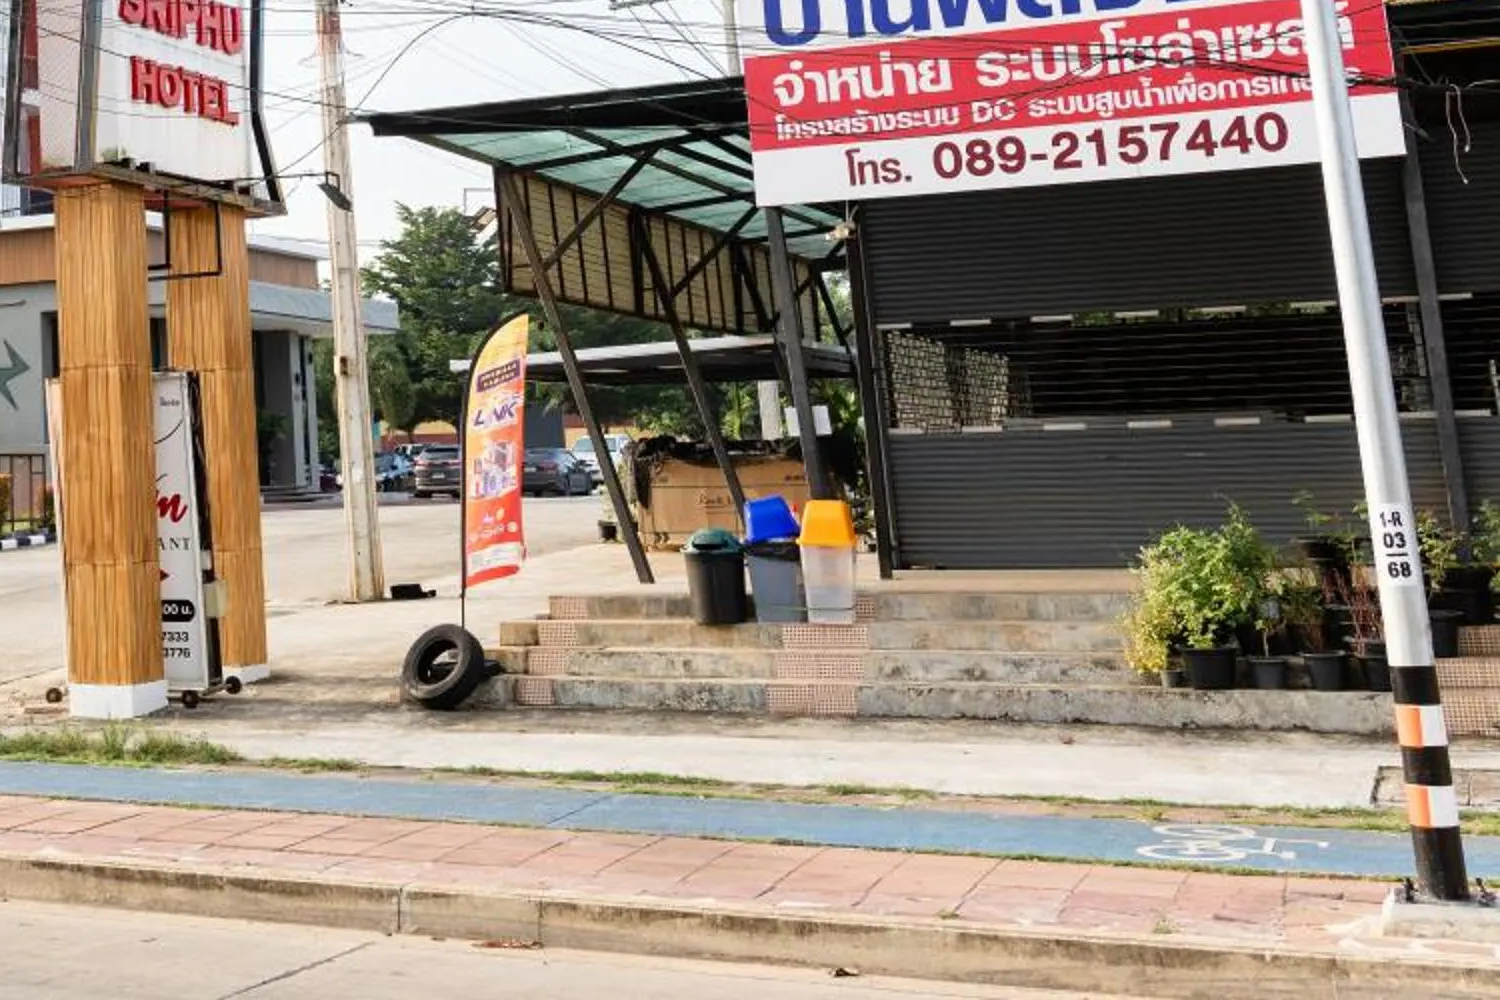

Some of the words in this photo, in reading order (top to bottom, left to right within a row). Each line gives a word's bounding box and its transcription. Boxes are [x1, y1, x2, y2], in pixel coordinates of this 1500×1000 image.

[129, 55, 240, 127] HOTEL
[772, 50, 953, 107] จำหน่าย
[971, 98, 1018, 124] DC
[845, 149, 912, 187] โทร.
[933, 111, 1289, 180] 089-2157440
[1379, 511, 1403, 528] 1-R
[1383, 532, 1407, 549] 03
[1387, 561, 1412, 578] 68
